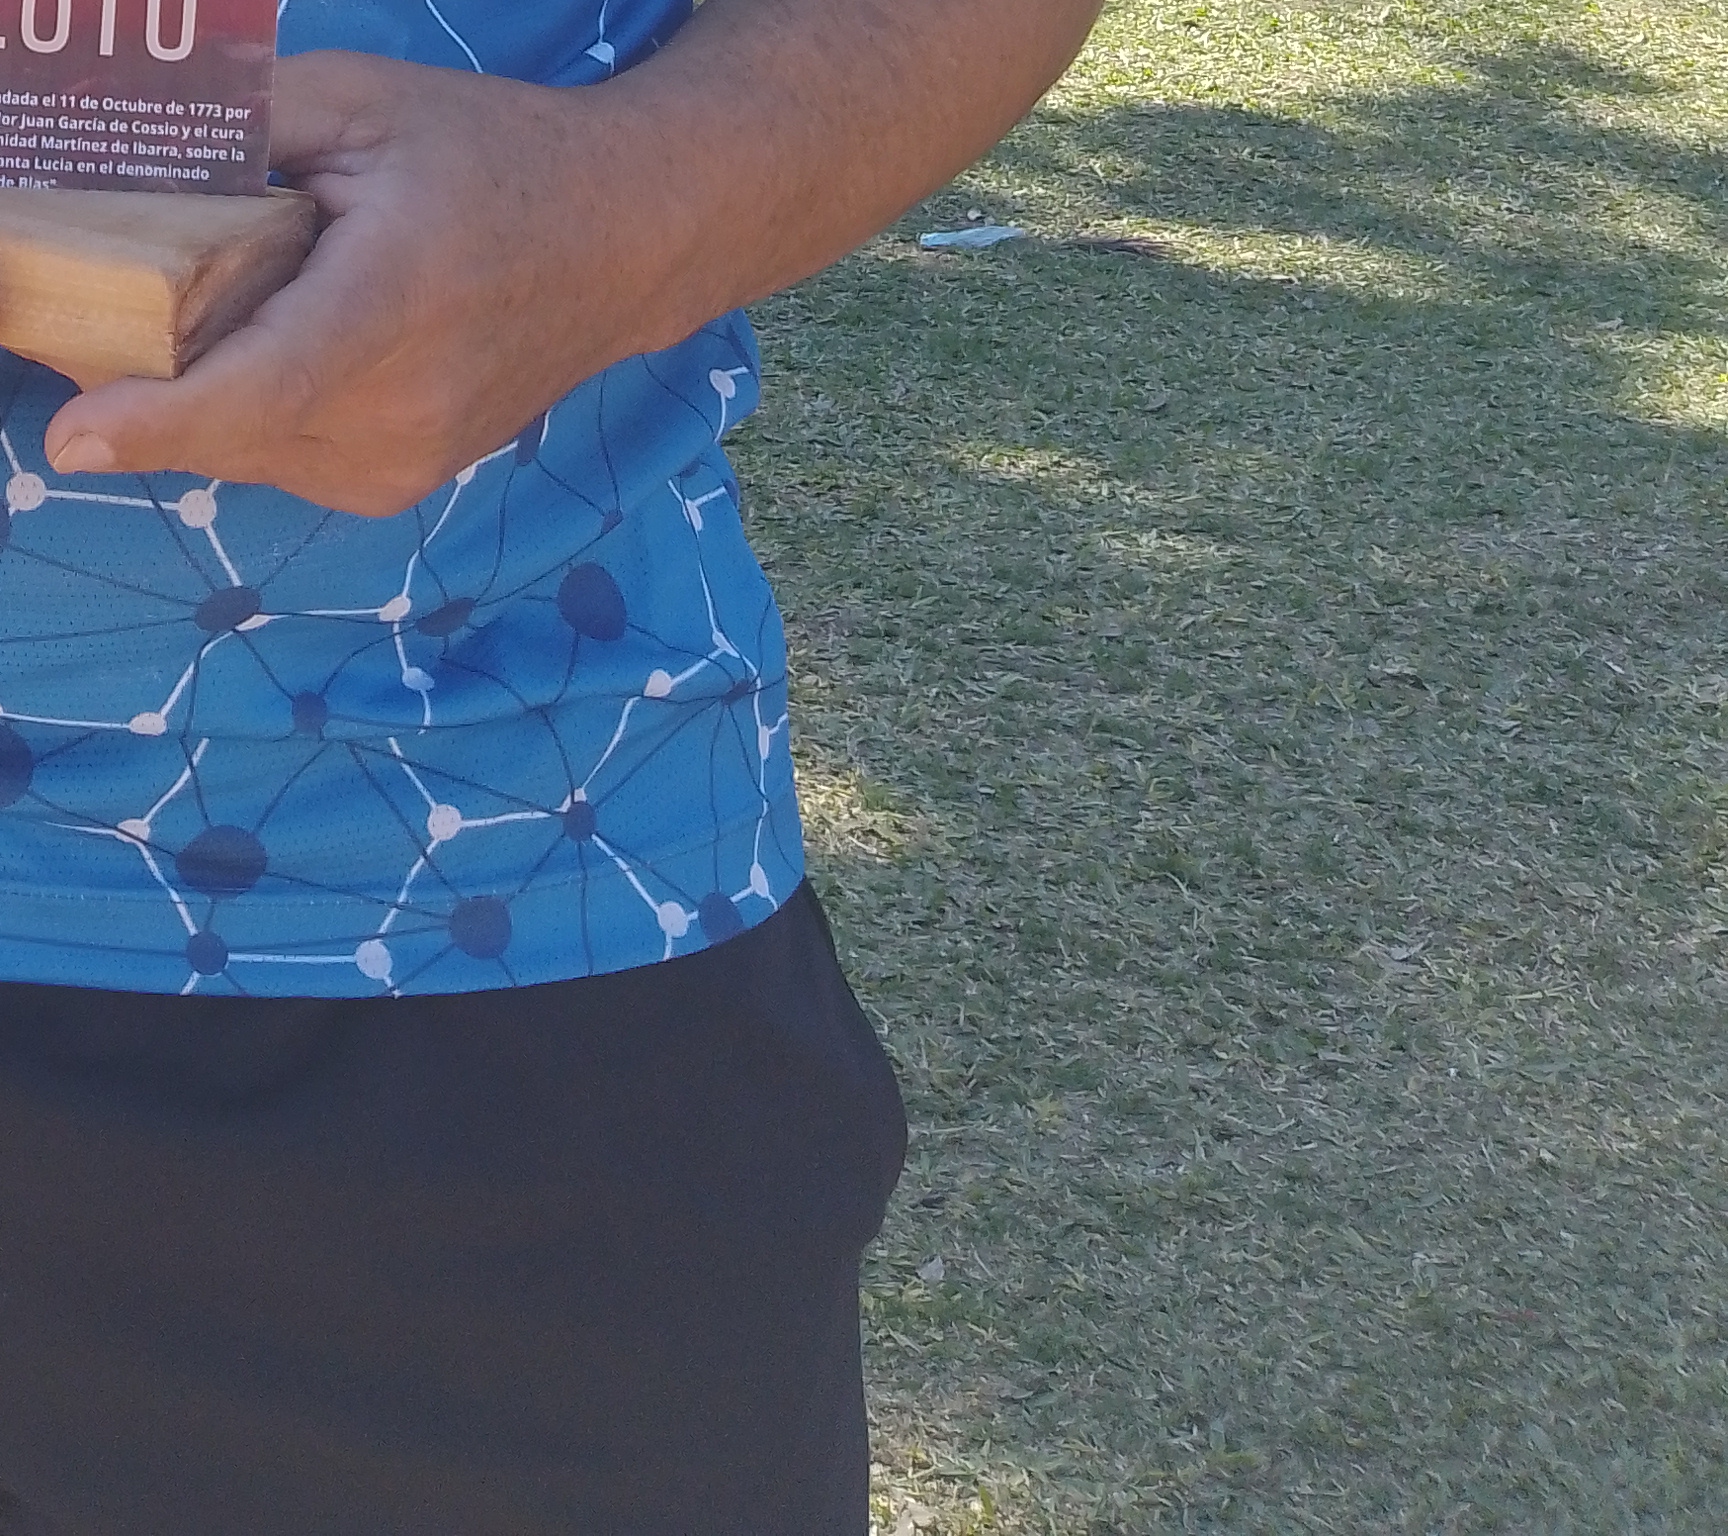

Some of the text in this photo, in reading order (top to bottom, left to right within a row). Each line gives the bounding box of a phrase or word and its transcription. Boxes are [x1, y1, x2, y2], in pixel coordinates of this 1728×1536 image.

[41, 93, 56, 108] el
[59, 94, 76, 109] 11
[79, 96, 100, 111] de
[102, 97, 163, 115] Octubre
[165, 100, 185, 116] de
[188, 102, 223, 119] 1773
[225, 106, 252, 123] por
[19, 114, 54, 130] Juan
[58, 115, 106, 133] García
[109, 118, 129, 134] de
[181, 125, 191, 141] y
[193, 125, 208, 140] el
[211, 128, 244, 142] cura
[41, 135, 108, 154] Martínez
[110, 139, 130, 154] de
[133, 141, 183, 160] Ibarra,
[185, 144, 228, 161] sobre
[230, 147, 246, 163] la
[76, 161, 97, 175] en
[99, 160, 113, 176] el
[116, 162, 211, 182] denominado
